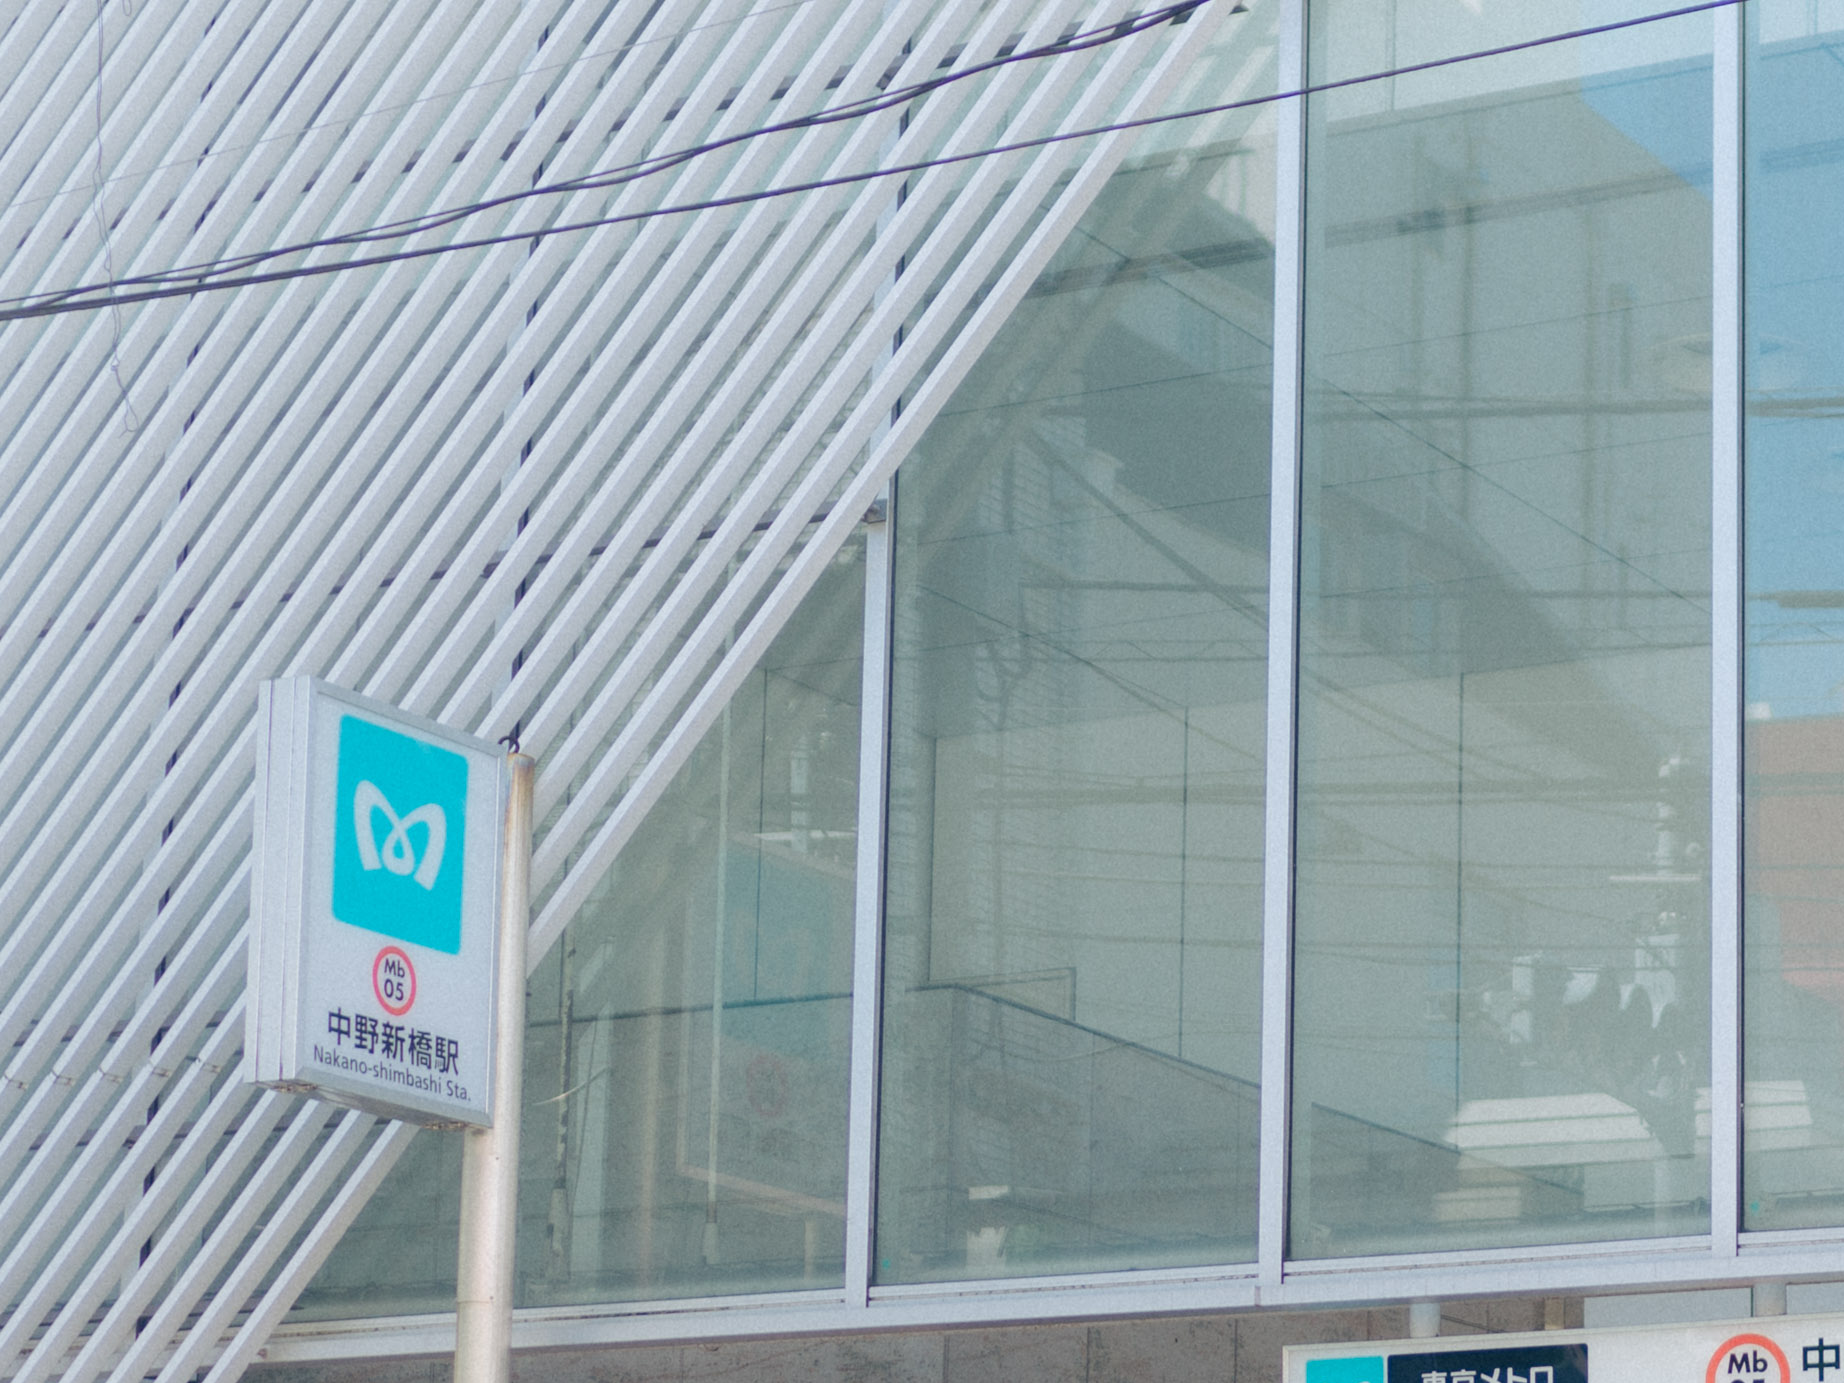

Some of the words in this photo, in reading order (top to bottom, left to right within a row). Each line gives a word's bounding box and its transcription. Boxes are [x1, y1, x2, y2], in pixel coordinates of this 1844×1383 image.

[383, 958, 406, 979] Mb
[383, 979, 405, 1002] 05
[327, 1006, 460, 1076] 中野新橋駅
[313, 1043, 443, 1095] Nakano-shimbashi
[446, 1074, 471, 1102] Sta.
[1727, 1352, 1768, 1375] Mb
